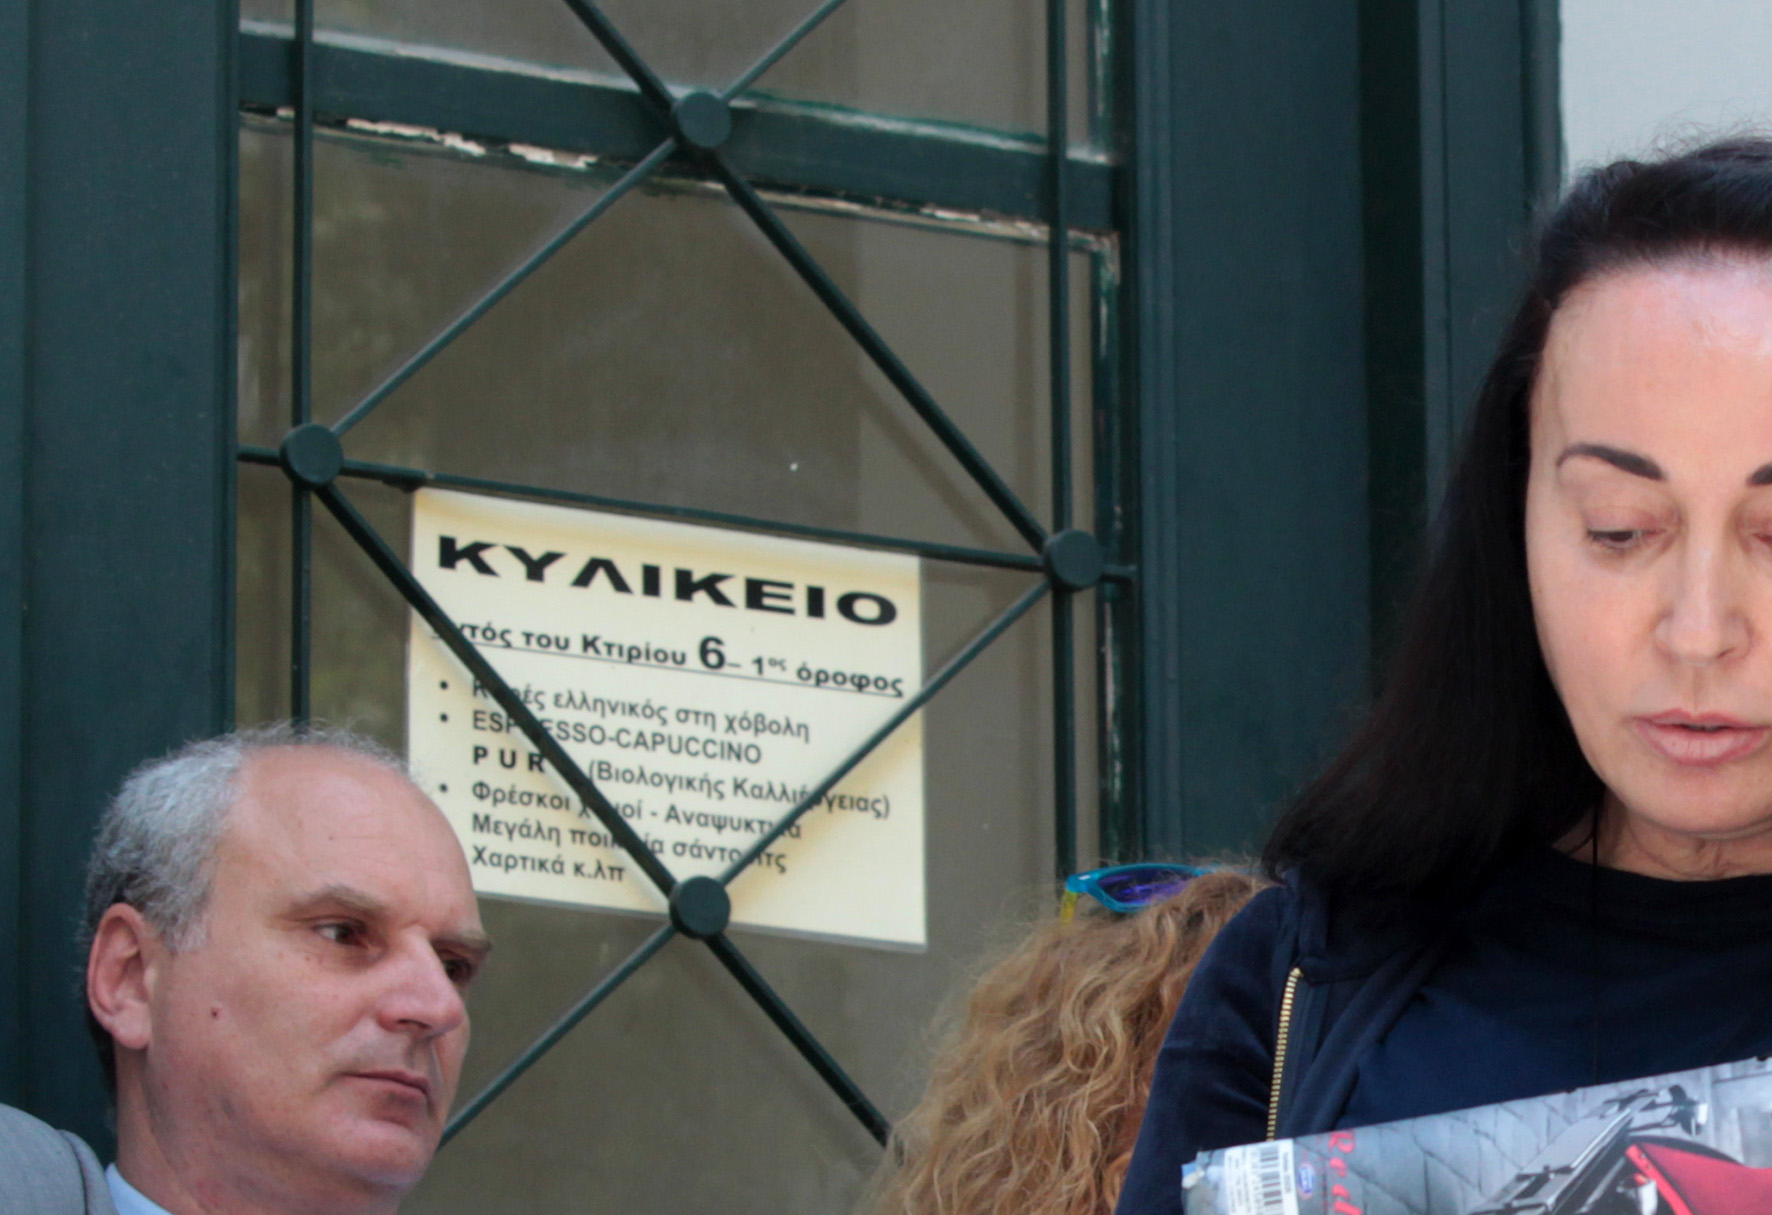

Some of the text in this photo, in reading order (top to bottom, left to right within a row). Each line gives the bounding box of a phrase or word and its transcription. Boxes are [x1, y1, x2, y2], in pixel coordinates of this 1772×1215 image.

[438, 534, 898, 627] ΚΥΛΙΚΕΙΟ
[521, 631, 570, 651] του
[582, 633, 687, 666] Κτιρίου
[797, 661, 904, 698] όροφος
[473, 710, 762, 765] ESPESSO-CAPUCCINO
[554, 690, 668, 726] ελληνικός
[676, 707, 717, 733] στη
[725, 711, 810, 744] χόβολη
[472, 781, 570, 807] Φρέσκοι
[589, 760, 725, 800] (Βιολογικής
[732, 776, 890, 819] Καλλιέγειας)
[472, 813, 561, 847] Μεγάλη
[672, 837, 787, 874] σάντοιτς
[472, 845, 626, 882] Χαρτικά κ.λπ
